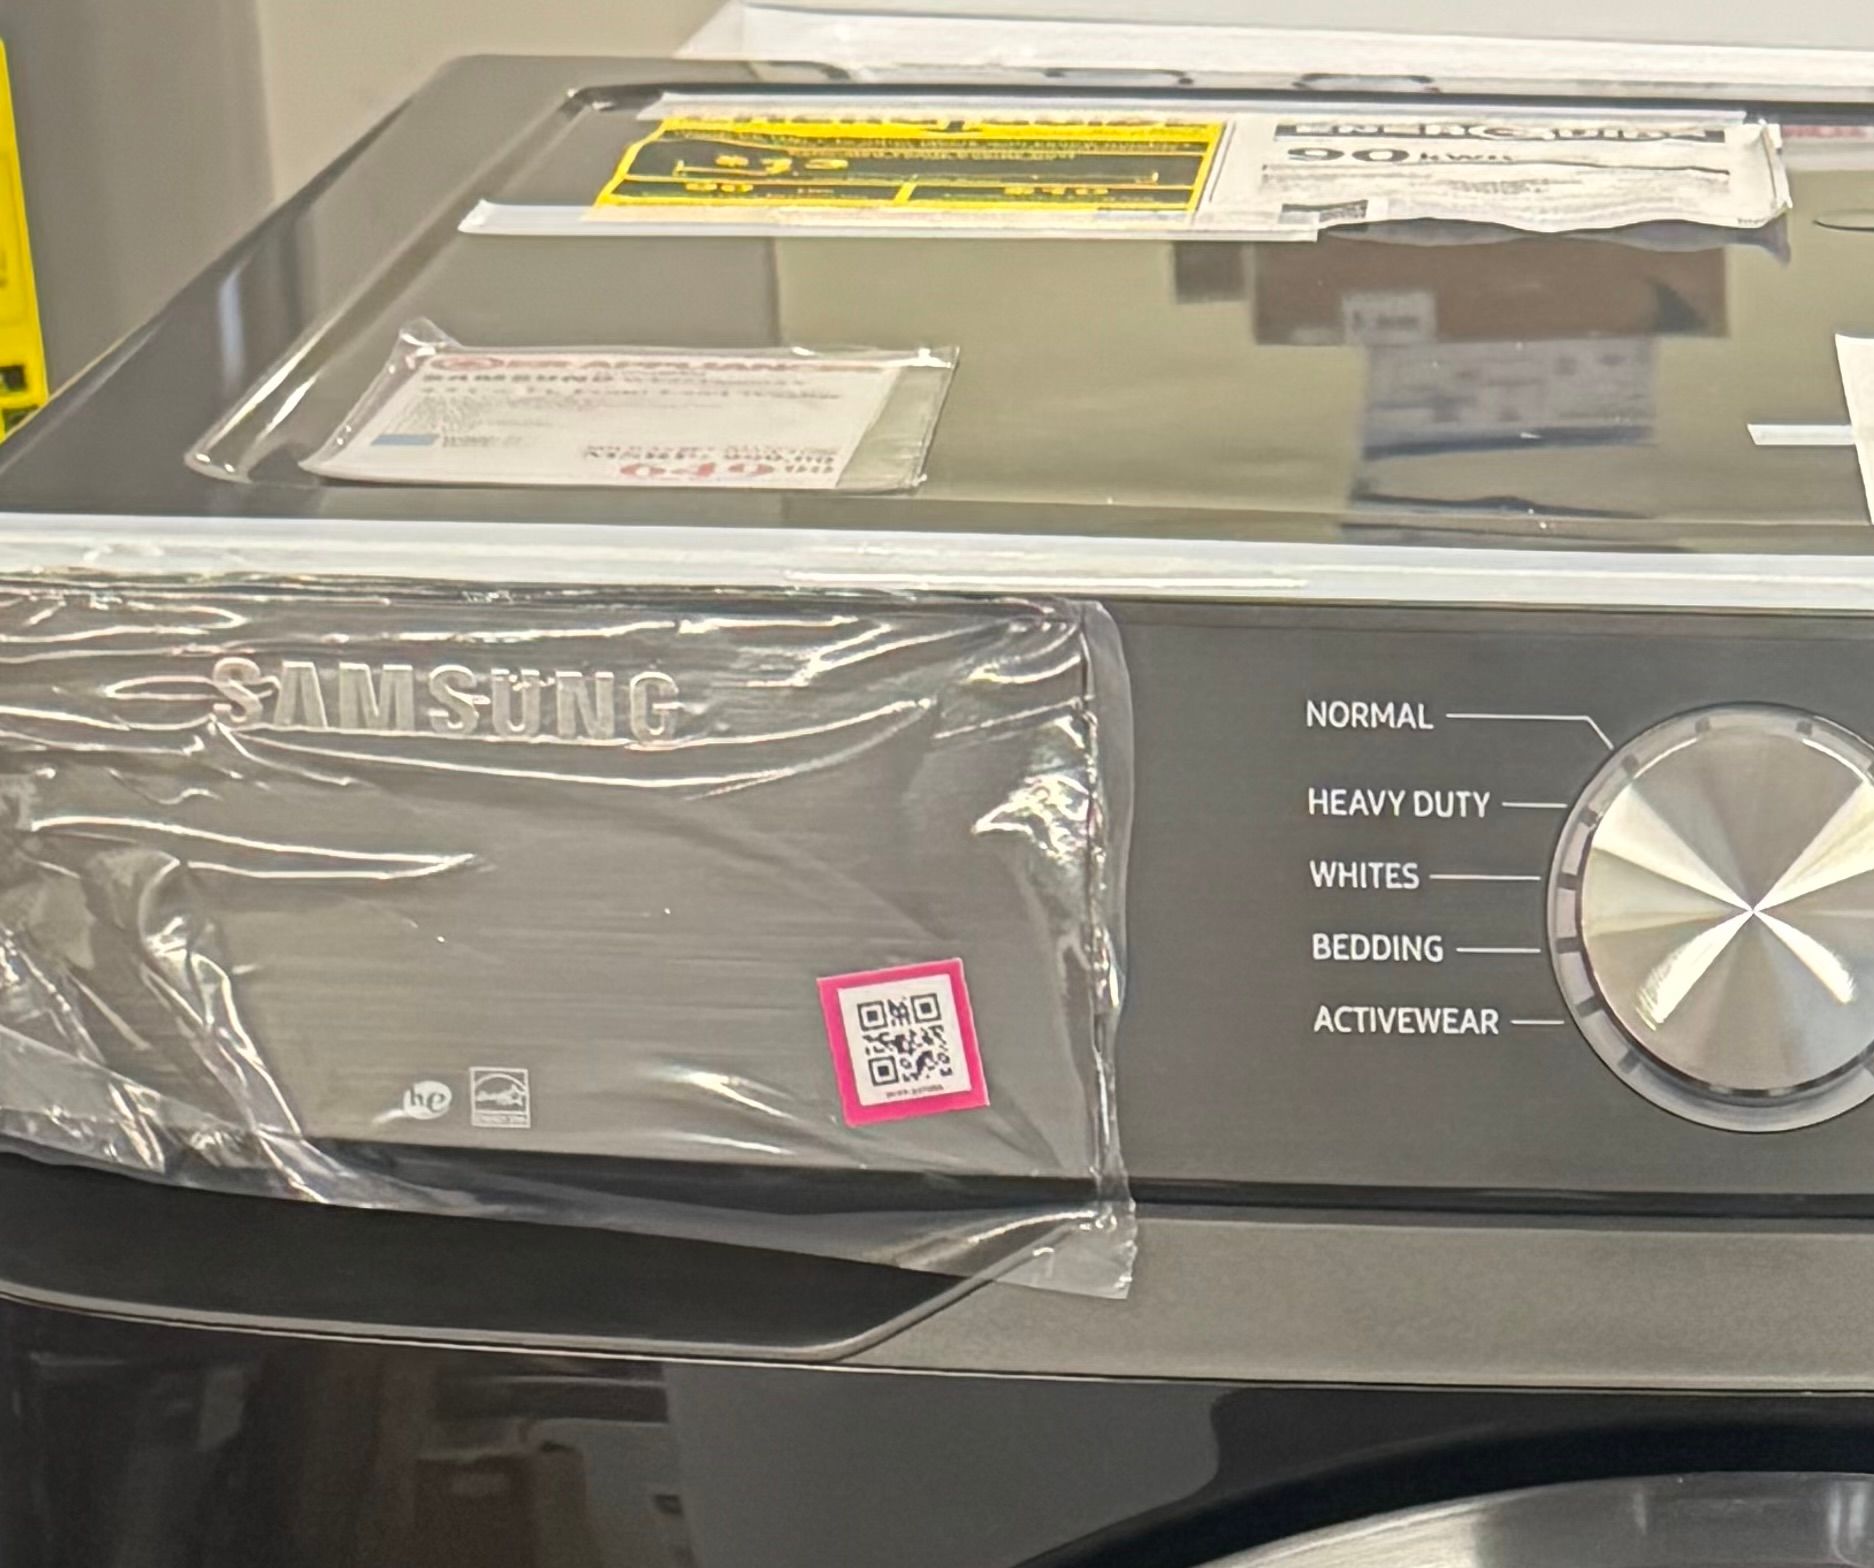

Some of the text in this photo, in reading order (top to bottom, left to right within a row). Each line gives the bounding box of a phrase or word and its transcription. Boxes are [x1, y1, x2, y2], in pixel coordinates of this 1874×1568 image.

[211, 656, 680, 743] SAMSUNG
[1306, 700, 1434, 730] NORMAL
[1308, 787, 1490, 818] HEAVY DUTY
[1309, 860, 1420, 889] WHITES
[1312, 933, 1443, 963] BEDDING
[1313, 1005, 1499, 1035] ACTIVEWEAR
